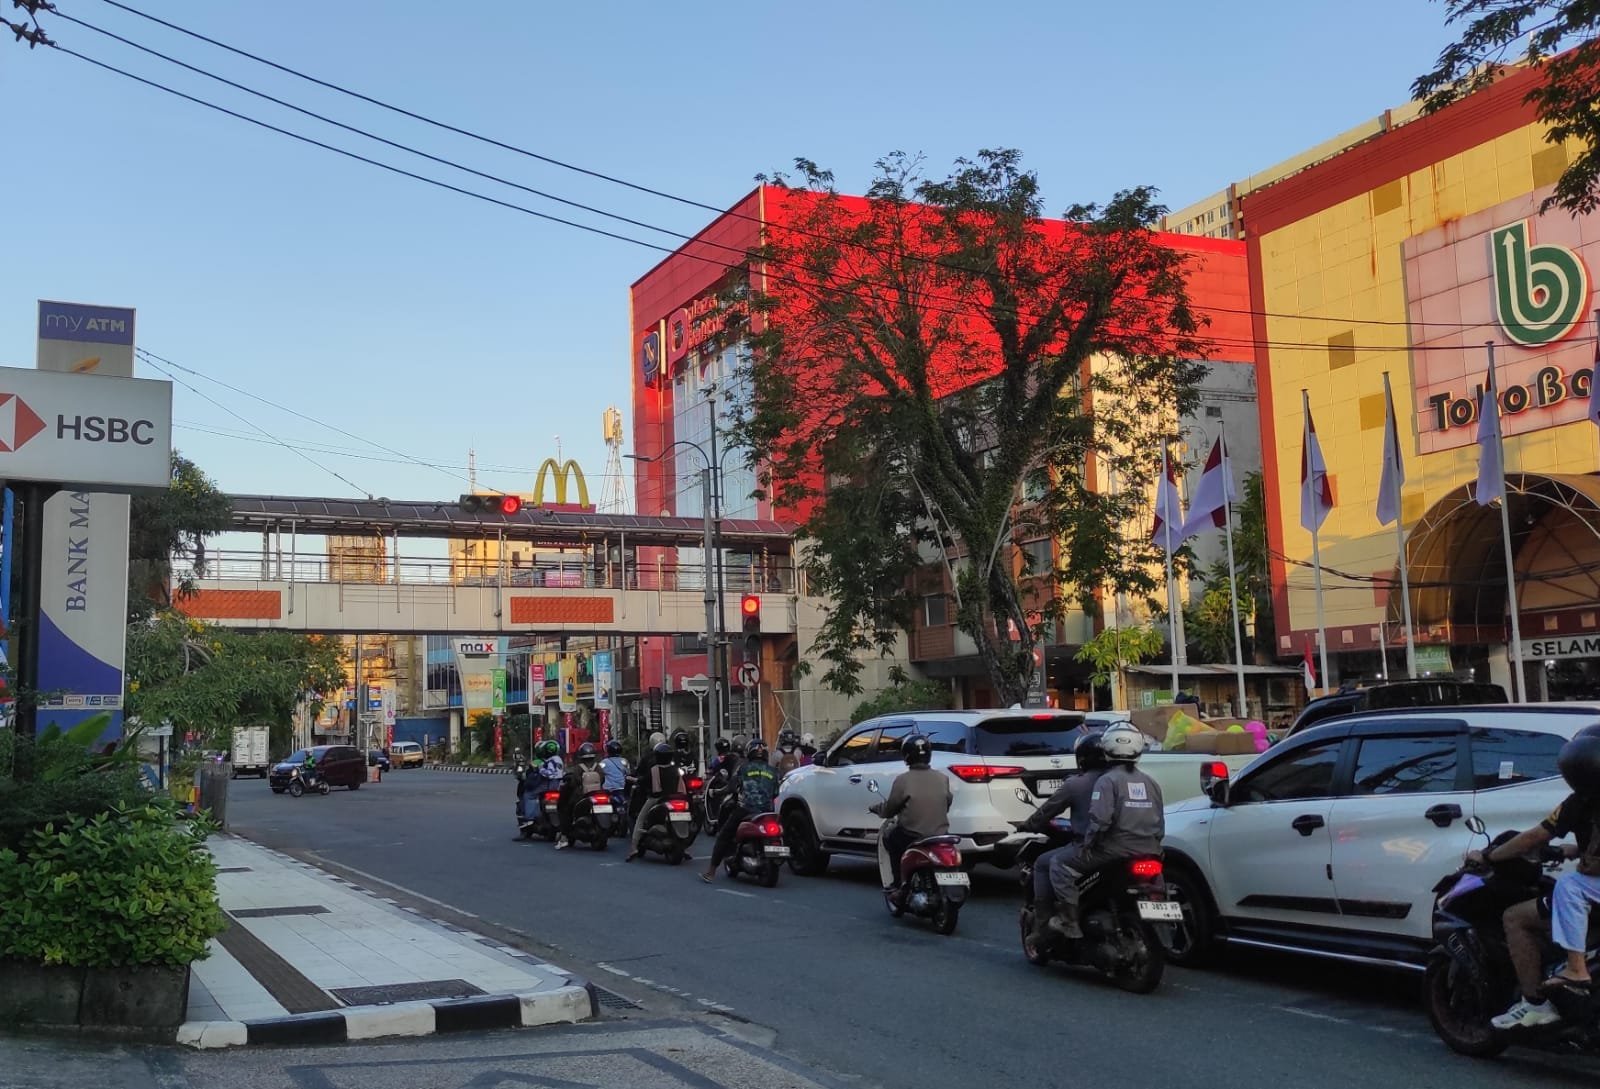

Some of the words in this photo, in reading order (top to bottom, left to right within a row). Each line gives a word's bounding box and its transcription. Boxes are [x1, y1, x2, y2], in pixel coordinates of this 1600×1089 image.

[46, 314, 84, 332] my
[86, 318, 125, 333] ATM
[57, 414, 155, 445] HSBC
[66, 536, 88, 612] BANK
[460, 643, 494, 652] max
[1531, 638, 1600, 656] SELAM
[1139, 902, 1148, 910] KT
